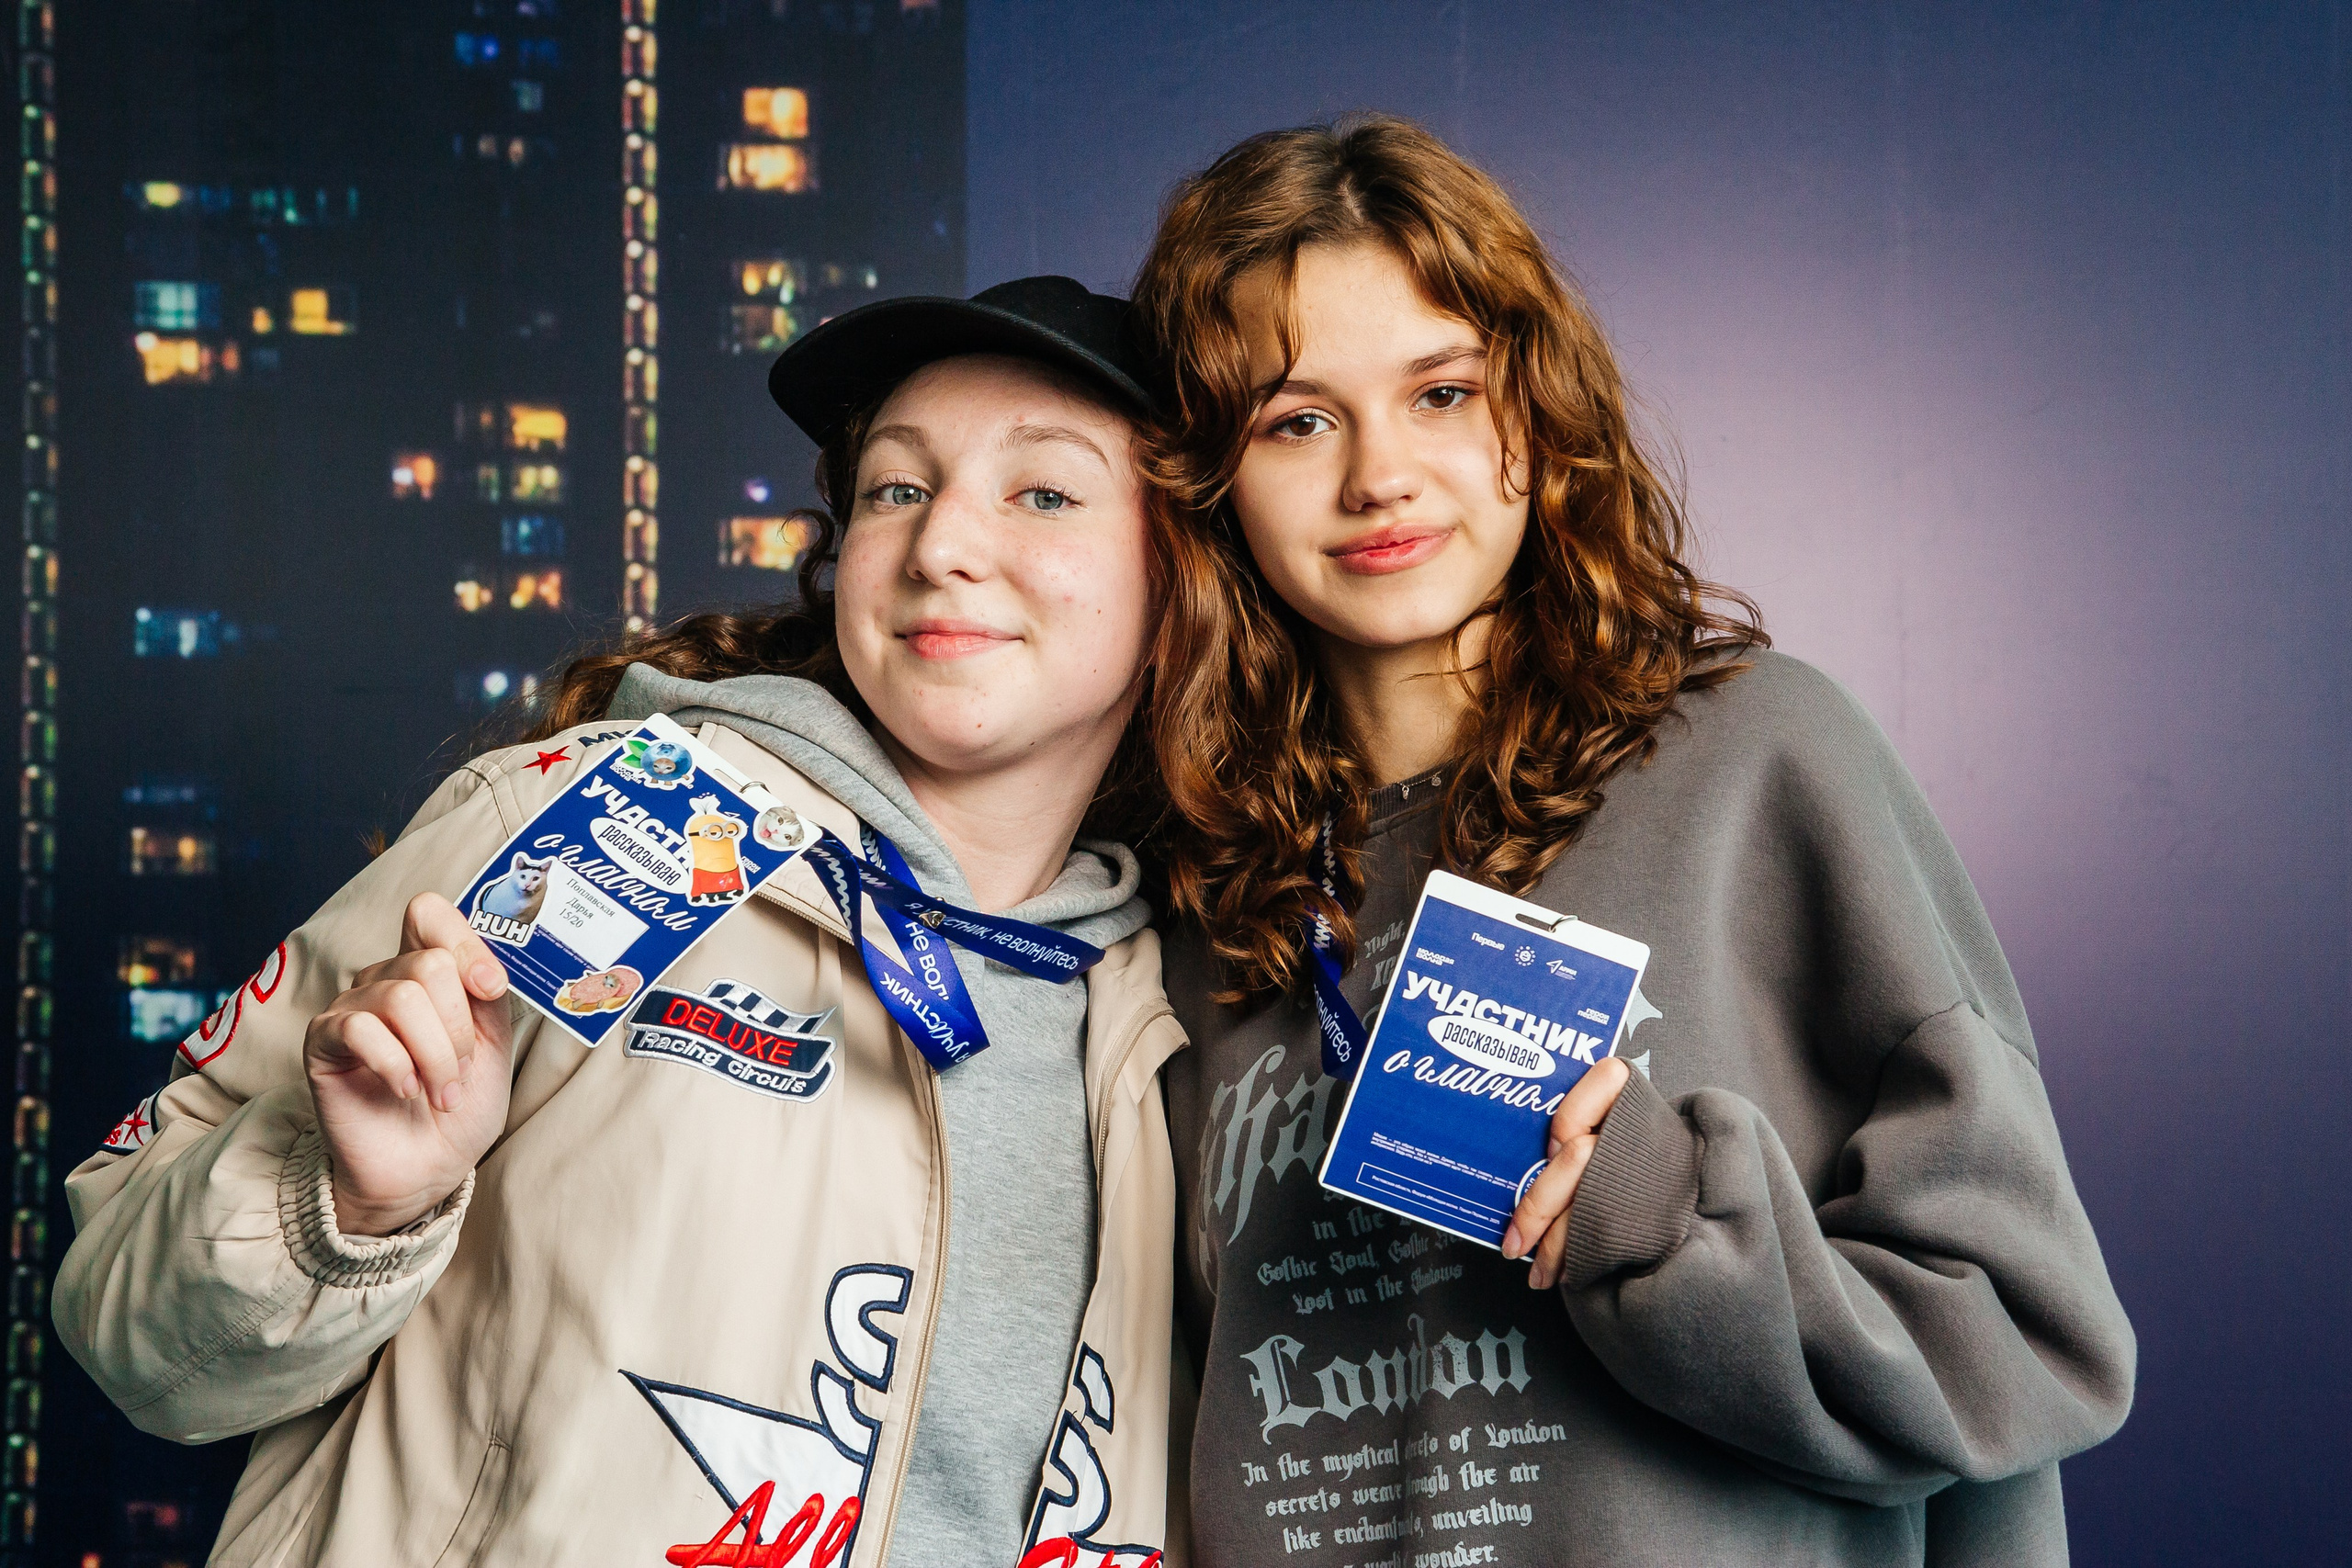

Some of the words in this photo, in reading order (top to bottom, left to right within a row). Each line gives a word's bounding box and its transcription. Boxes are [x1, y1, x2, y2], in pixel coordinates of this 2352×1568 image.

[580, 774, 691, 872] УЧАСТ
[597, 824, 682, 886] рассказываю
[555, 844, 700, 932] главном
[565, 897, 594, 919] Дарья
[566, 878, 616, 918] Поплавская
[471, 911, 530, 942] HUH
[559, 908, 584, 929] 15/20
[1009, 931, 1080, 972] волнуйтесь
[1471, 931, 1506, 951] Первые
[661, 998, 798, 1066] DELUXE
[1402, 970, 1605, 1066] УЧАСТНИК
[638, 1031, 723, 1066] Racing
[1442, 1021, 1541, 1071] рассказываю
[1312, 1221, 1339, 1240] in
[1346, 1206, 1385, 1237] the
[1257, 1256, 1317, 1286] Gothic
[1345, 1288, 1369, 1305] in
[1375, 1275, 1404, 1302] the
[1239, 1313, 1532, 1445] London
[1241, 1462, 1270, 1487] In
[1276, 1452, 1313, 1481] the
[1321, 1438, 1400, 1483] mystical
[1449, 1426, 1472, 1454] of
[1485, 1418, 1566, 1449] London
[1265, 1486, 1341, 1517] secrets
[1458, 1461, 1498, 1491] the
[1510, 1462, 1540, 1483] air
[1283, 1525, 1322, 1554] like
[1431, 1496, 1532, 1527] unveiling
[1415, 1541, 1498, 1568] wonder.
